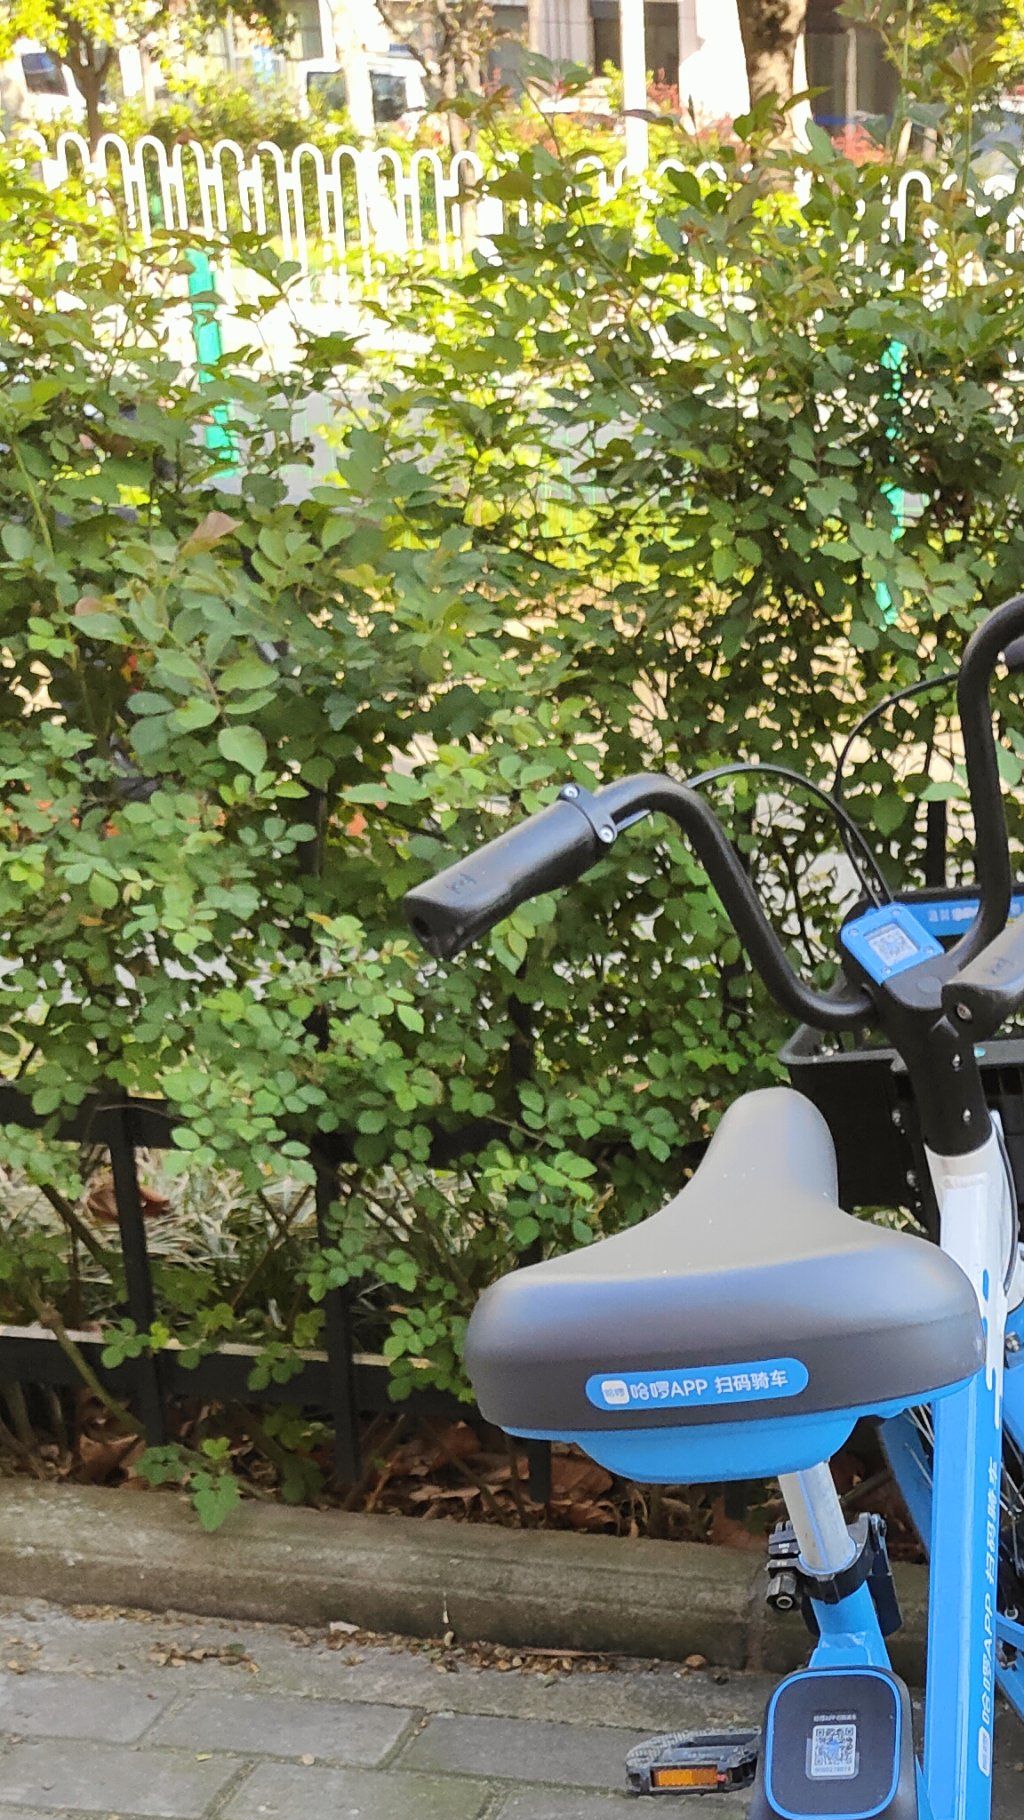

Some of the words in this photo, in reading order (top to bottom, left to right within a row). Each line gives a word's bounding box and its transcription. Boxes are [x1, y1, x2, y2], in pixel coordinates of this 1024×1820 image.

[630, 1380, 708, 1400] 哈啰APP
[714, 1369, 788, 1394] 扫码骑车
